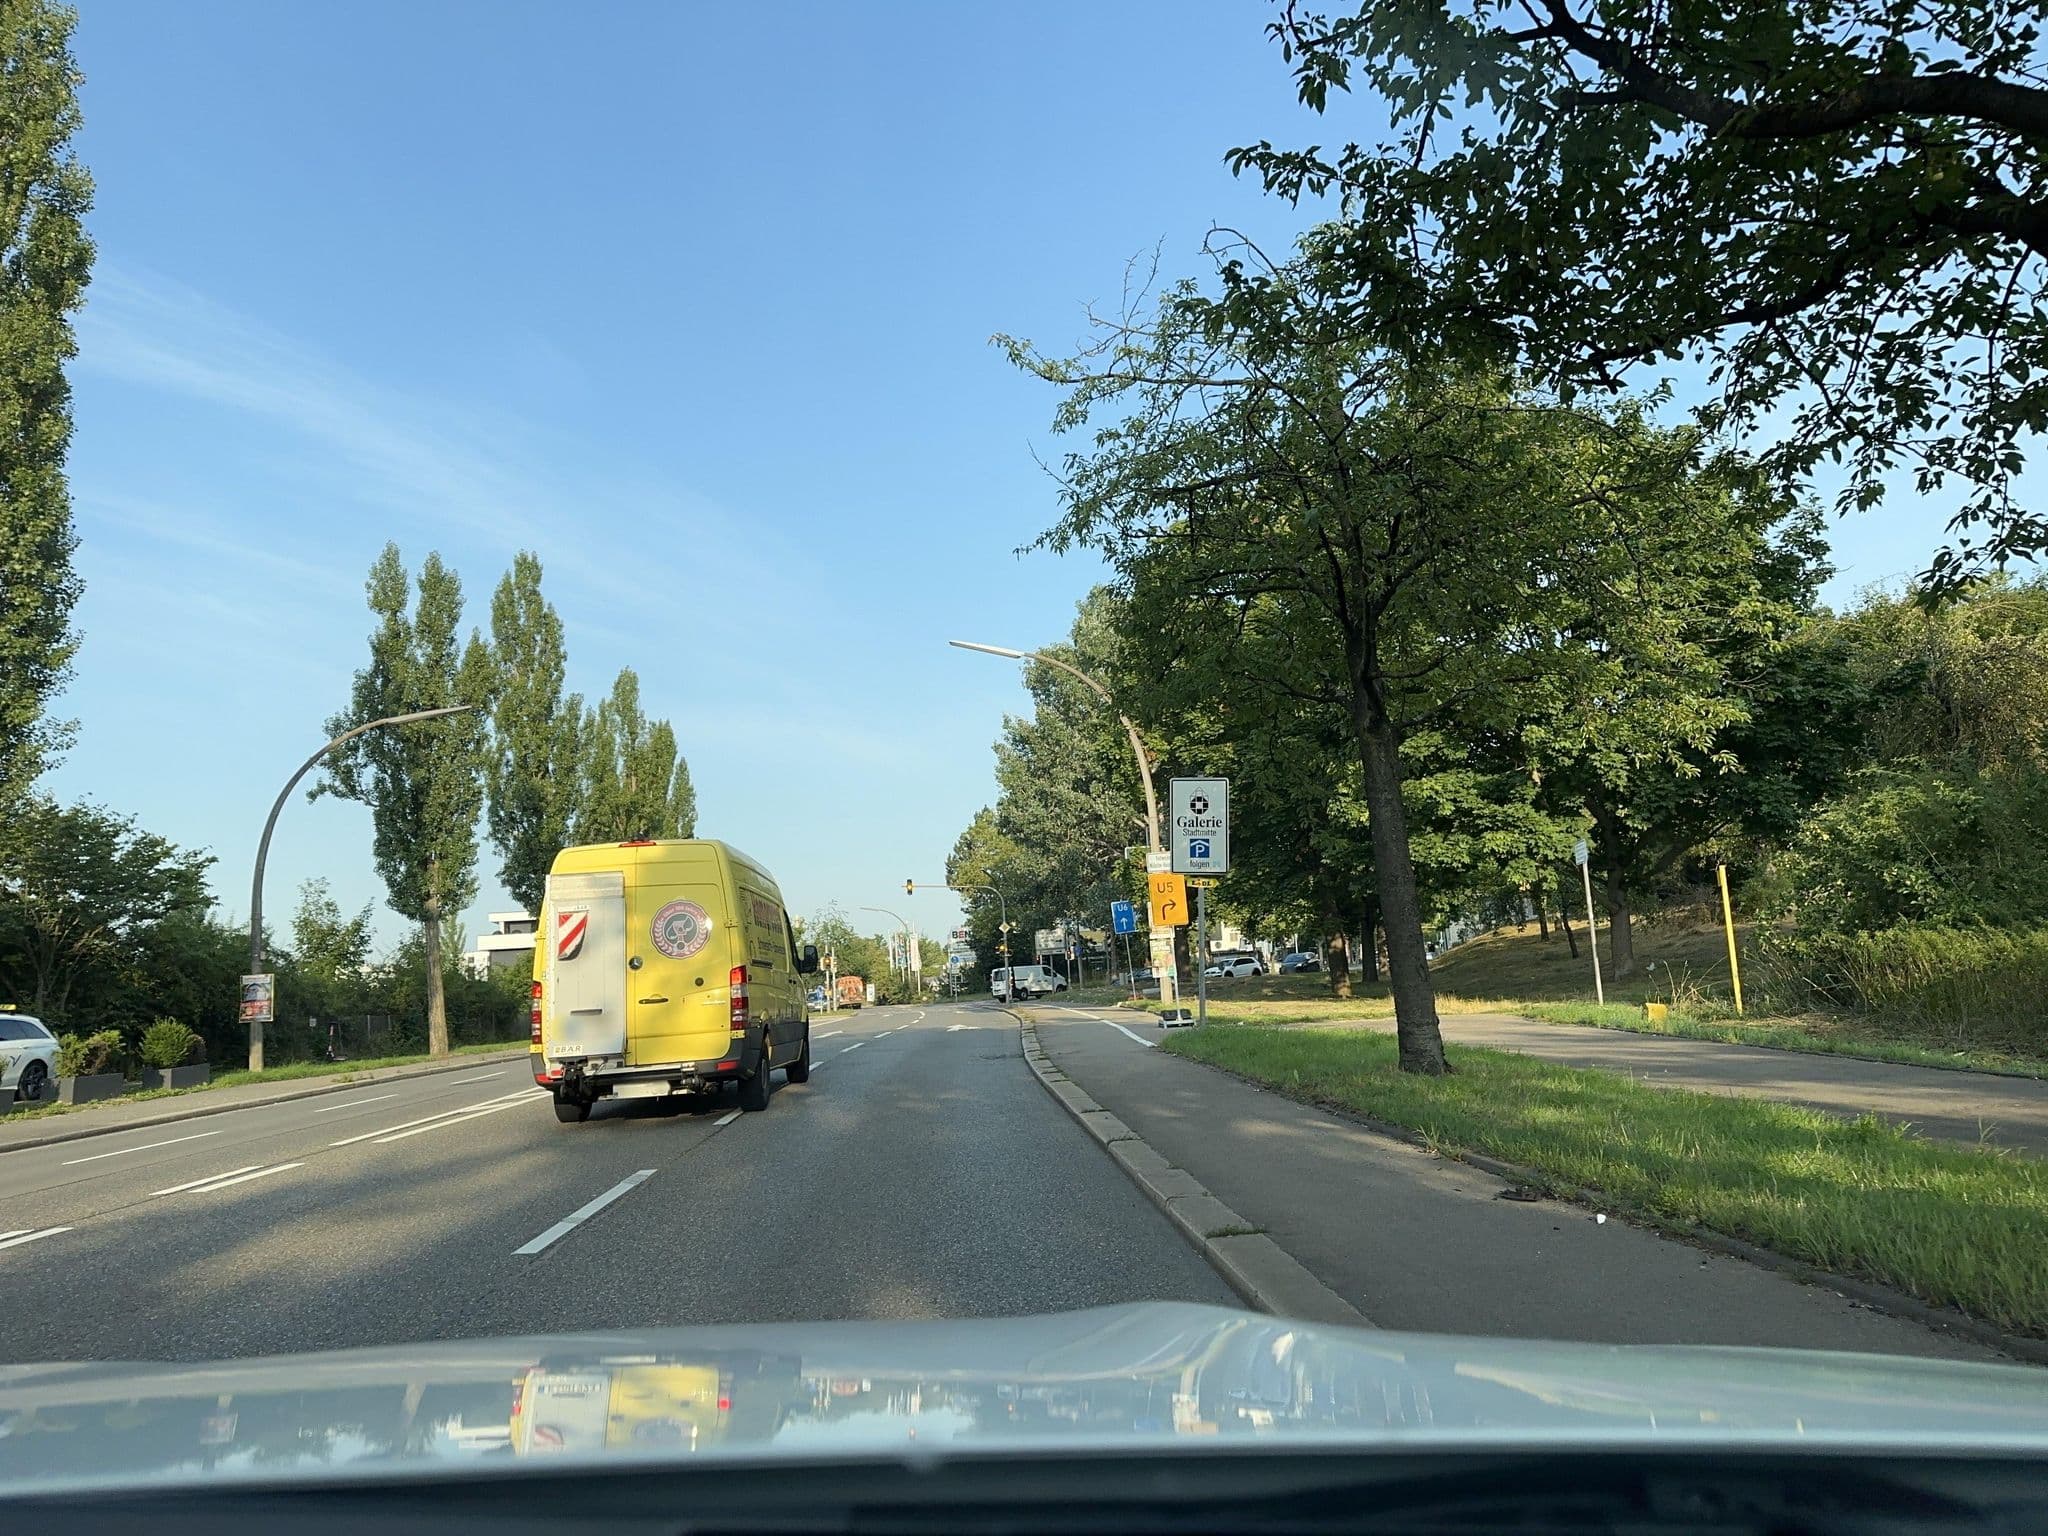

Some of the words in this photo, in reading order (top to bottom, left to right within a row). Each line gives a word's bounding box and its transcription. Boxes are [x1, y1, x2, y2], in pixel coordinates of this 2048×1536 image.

[1176, 815, 1223, 828] Galerie
[1189, 860, 1210, 870] folgen
[1157, 881, 1175, 894] U5
[1117, 903, 1129, 912] U6
